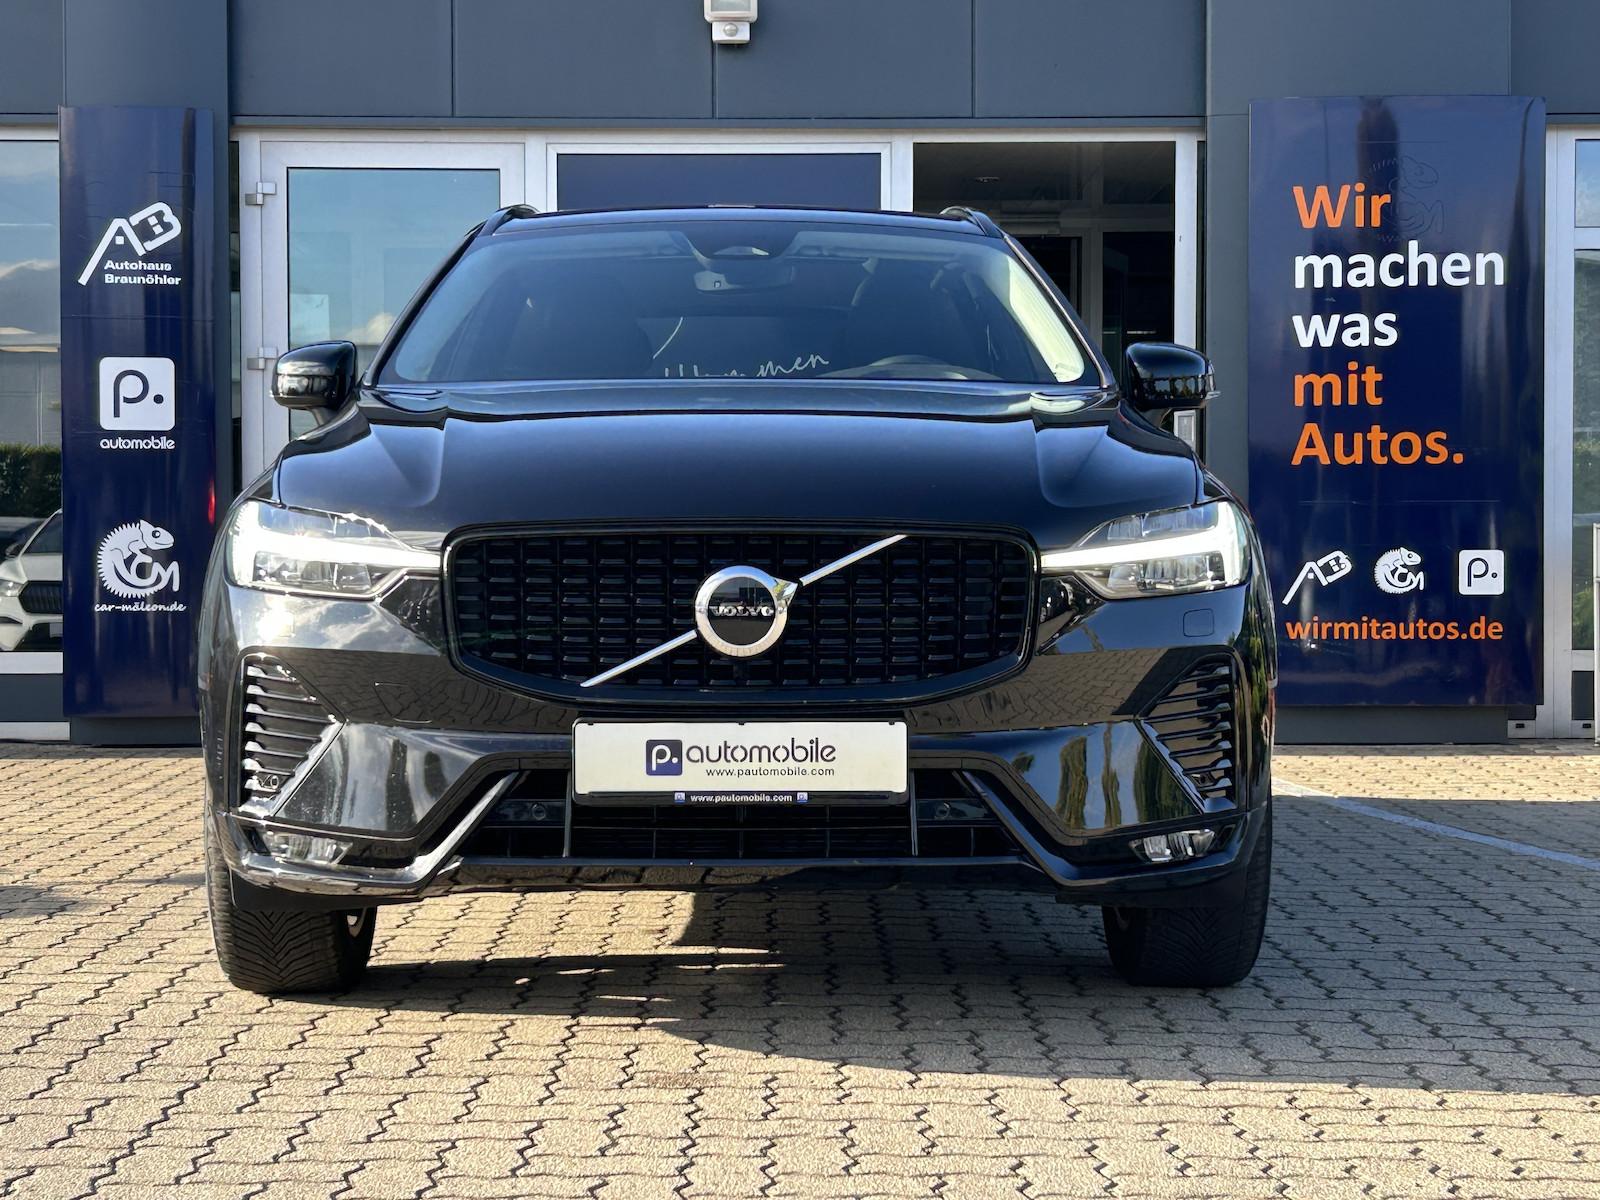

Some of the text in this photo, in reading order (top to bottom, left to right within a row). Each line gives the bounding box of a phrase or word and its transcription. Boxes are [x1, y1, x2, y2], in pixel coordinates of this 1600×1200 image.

[1292, 182, 1391, 228] Wir
[104, 260, 172, 271] Autohaus
[1294, 240, 1505, 288] machen
[104, 274, 181, 285] Braunöhler
[1292, 312, 1398, 348] was
[1294, 361, 1383, 406] mit
[100, 436, 175, 449] automobile
[1291, 423, 1465, 465] Autos.
[709, 605, 774, 617] VOLVO
[1285, 616, 1504, 640] wirmitautos.de
[686, 737, 836, 763] automobile
[705, 767, 835, 778] www.pautomobile.com
[690, 793, 793, 803] www.pautomobile.com
